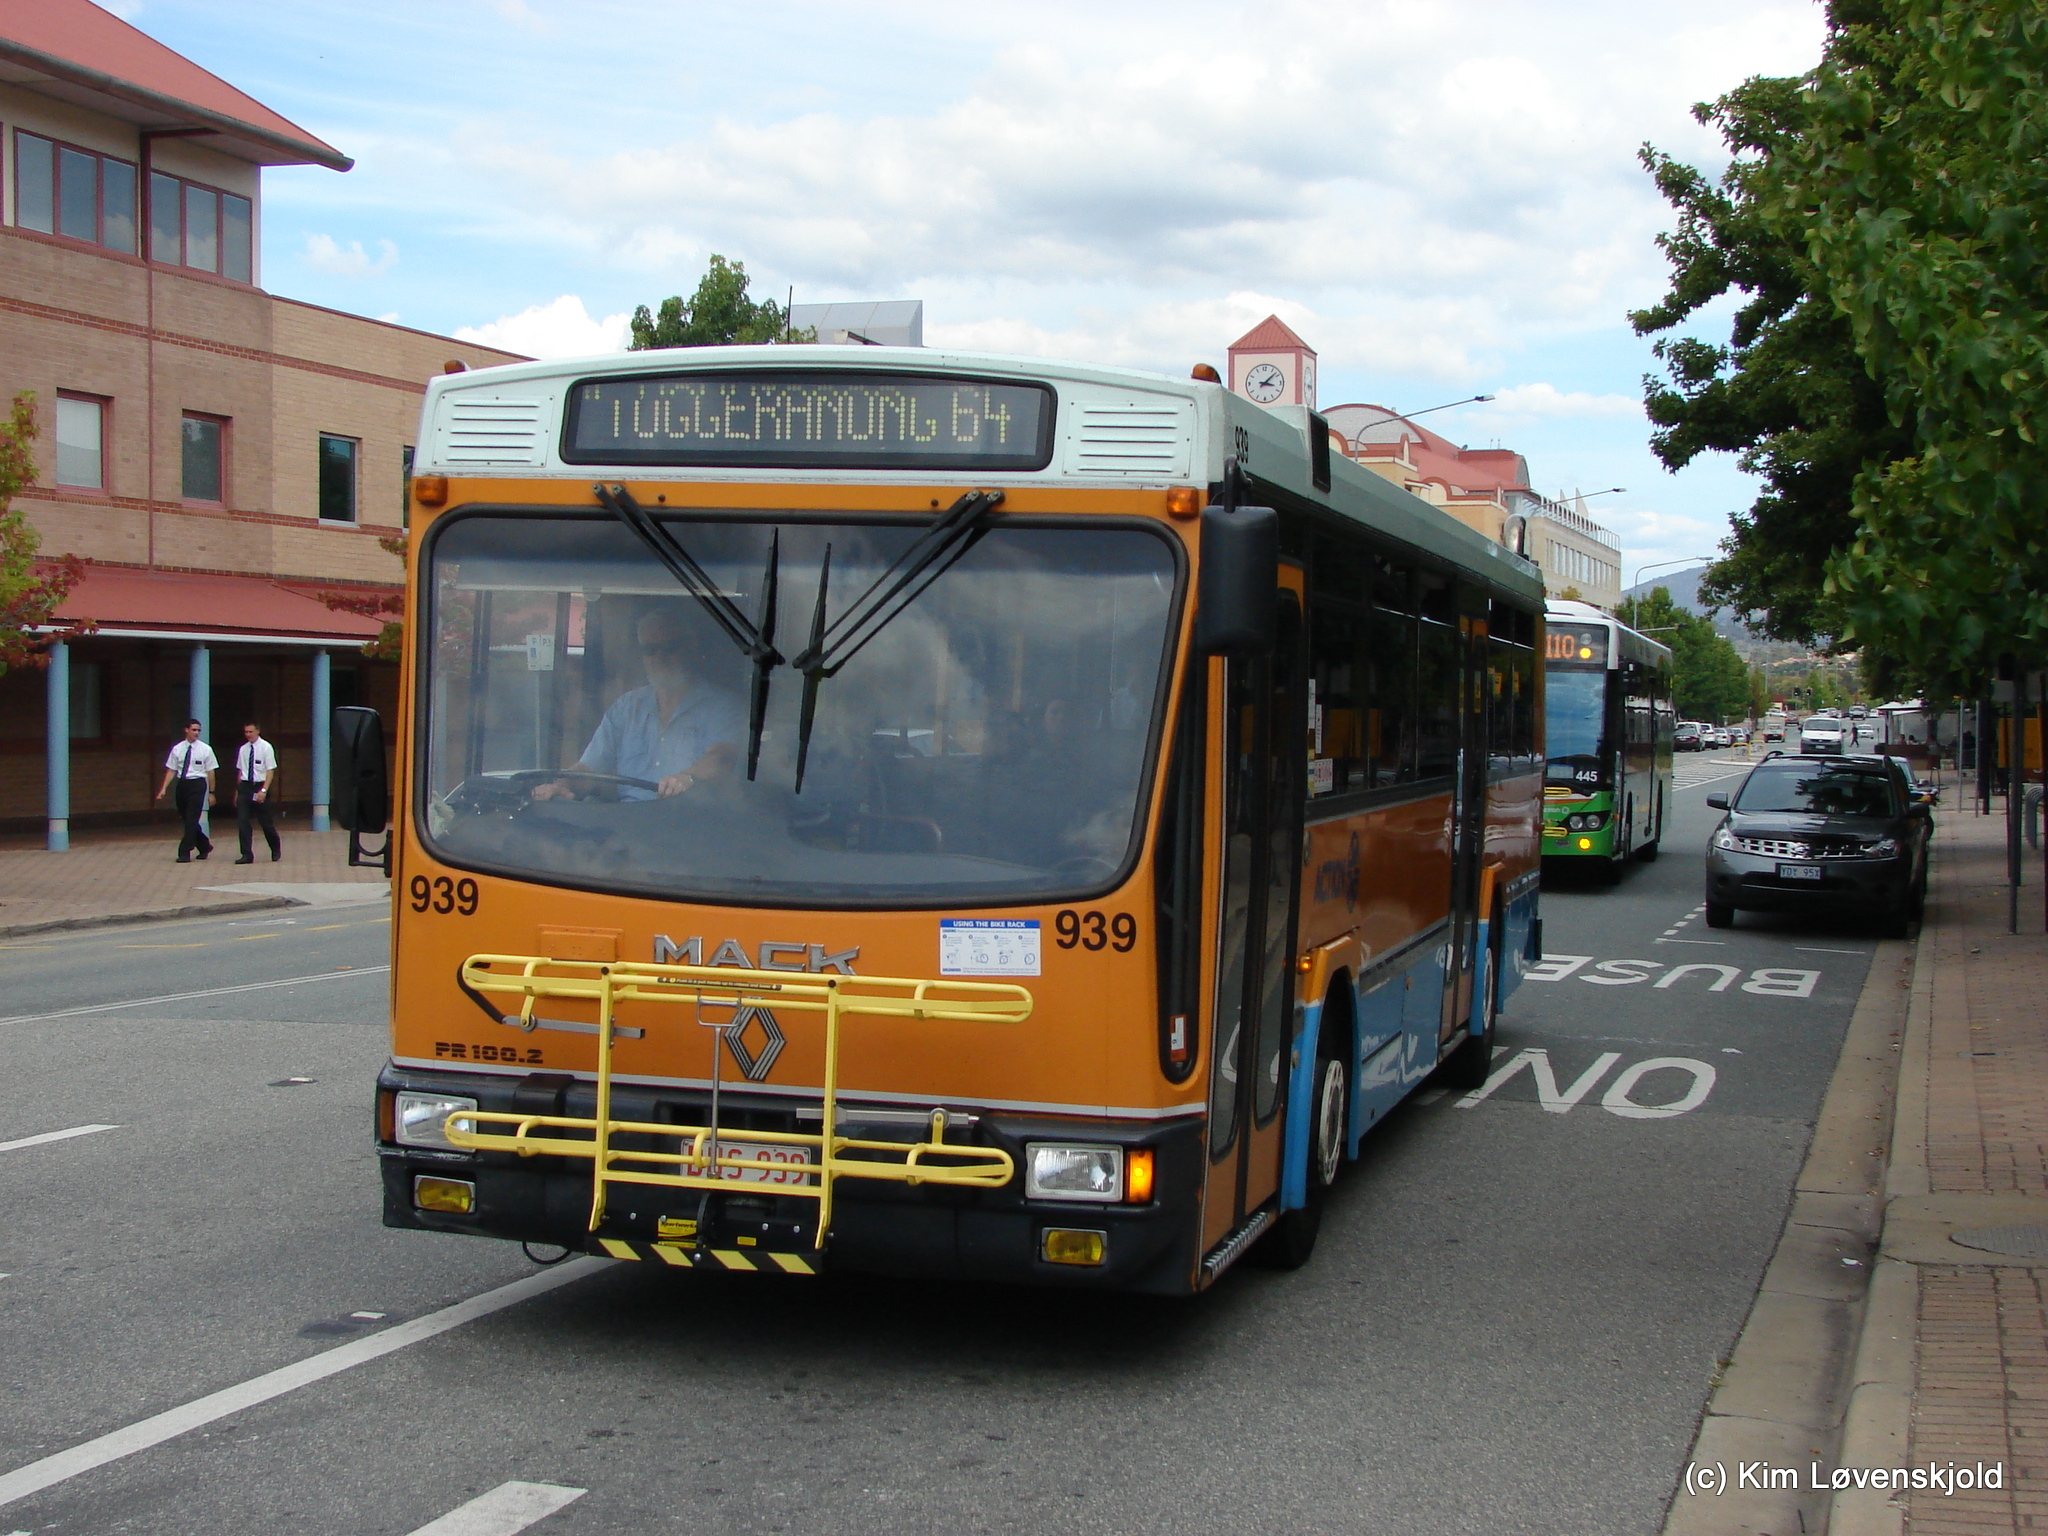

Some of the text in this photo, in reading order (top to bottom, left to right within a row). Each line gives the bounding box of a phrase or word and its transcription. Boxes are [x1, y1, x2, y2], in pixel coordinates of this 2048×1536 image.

[585, 384, 1011, 443] TUGGERANONG 64
[1235, 425, 1249, 464] 939
[1545, 634, 1575, 659] 110
[1575, 770, 1598, 782] 445
[410, 875, 479, 916] 939
[1055, 910, 1137, 953] 939
[652, 934, 860, 976] MACK
[757, 1151, 805, 1184] 939
